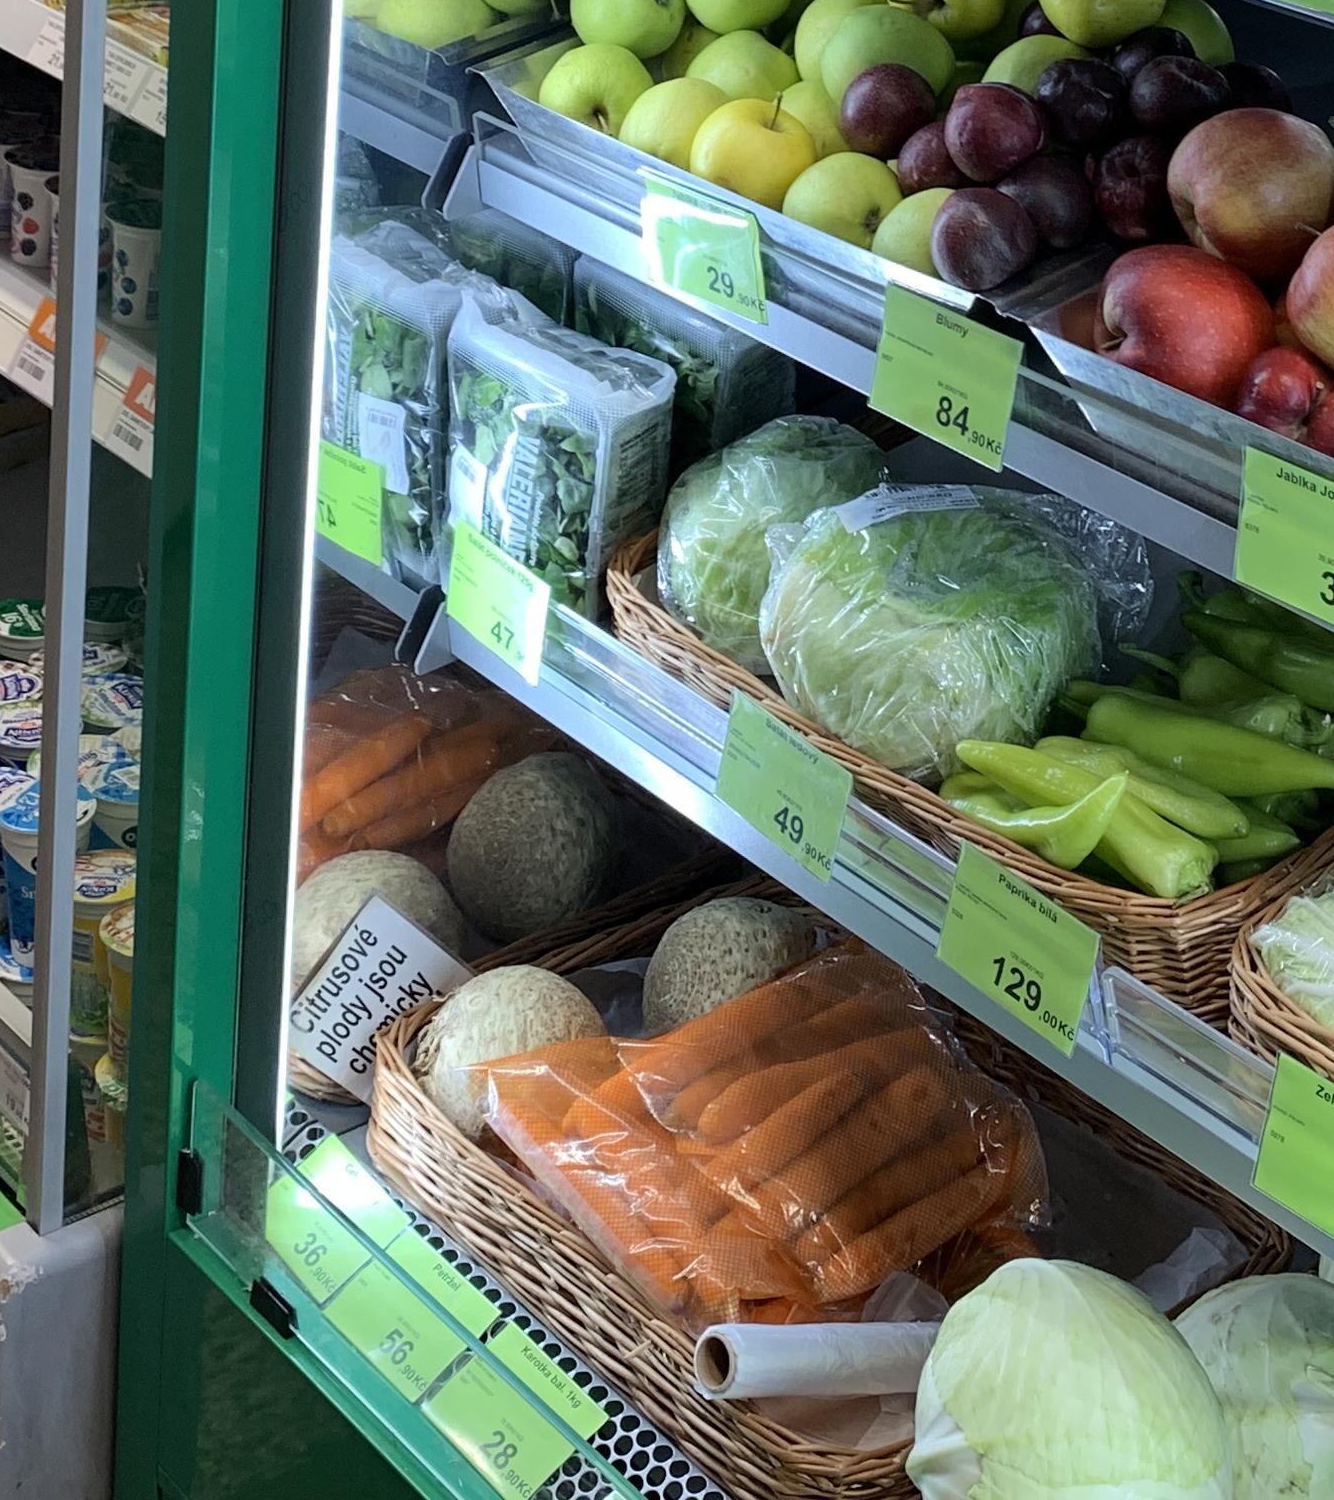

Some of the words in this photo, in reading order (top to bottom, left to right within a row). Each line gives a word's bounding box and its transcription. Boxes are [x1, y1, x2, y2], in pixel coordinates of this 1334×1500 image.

[1276, 467, 1317, 493] Jablka
[998, 874, 1038, 910] Paprika
[290, 924, 379, 1033] Citrusové
[316, 994, 373, 1063] plody
[359, 944, 408, 1002] jsou
[432, 1262, 462, 1292] Petržel
[520, 1344, 551, 1379] Karotka
